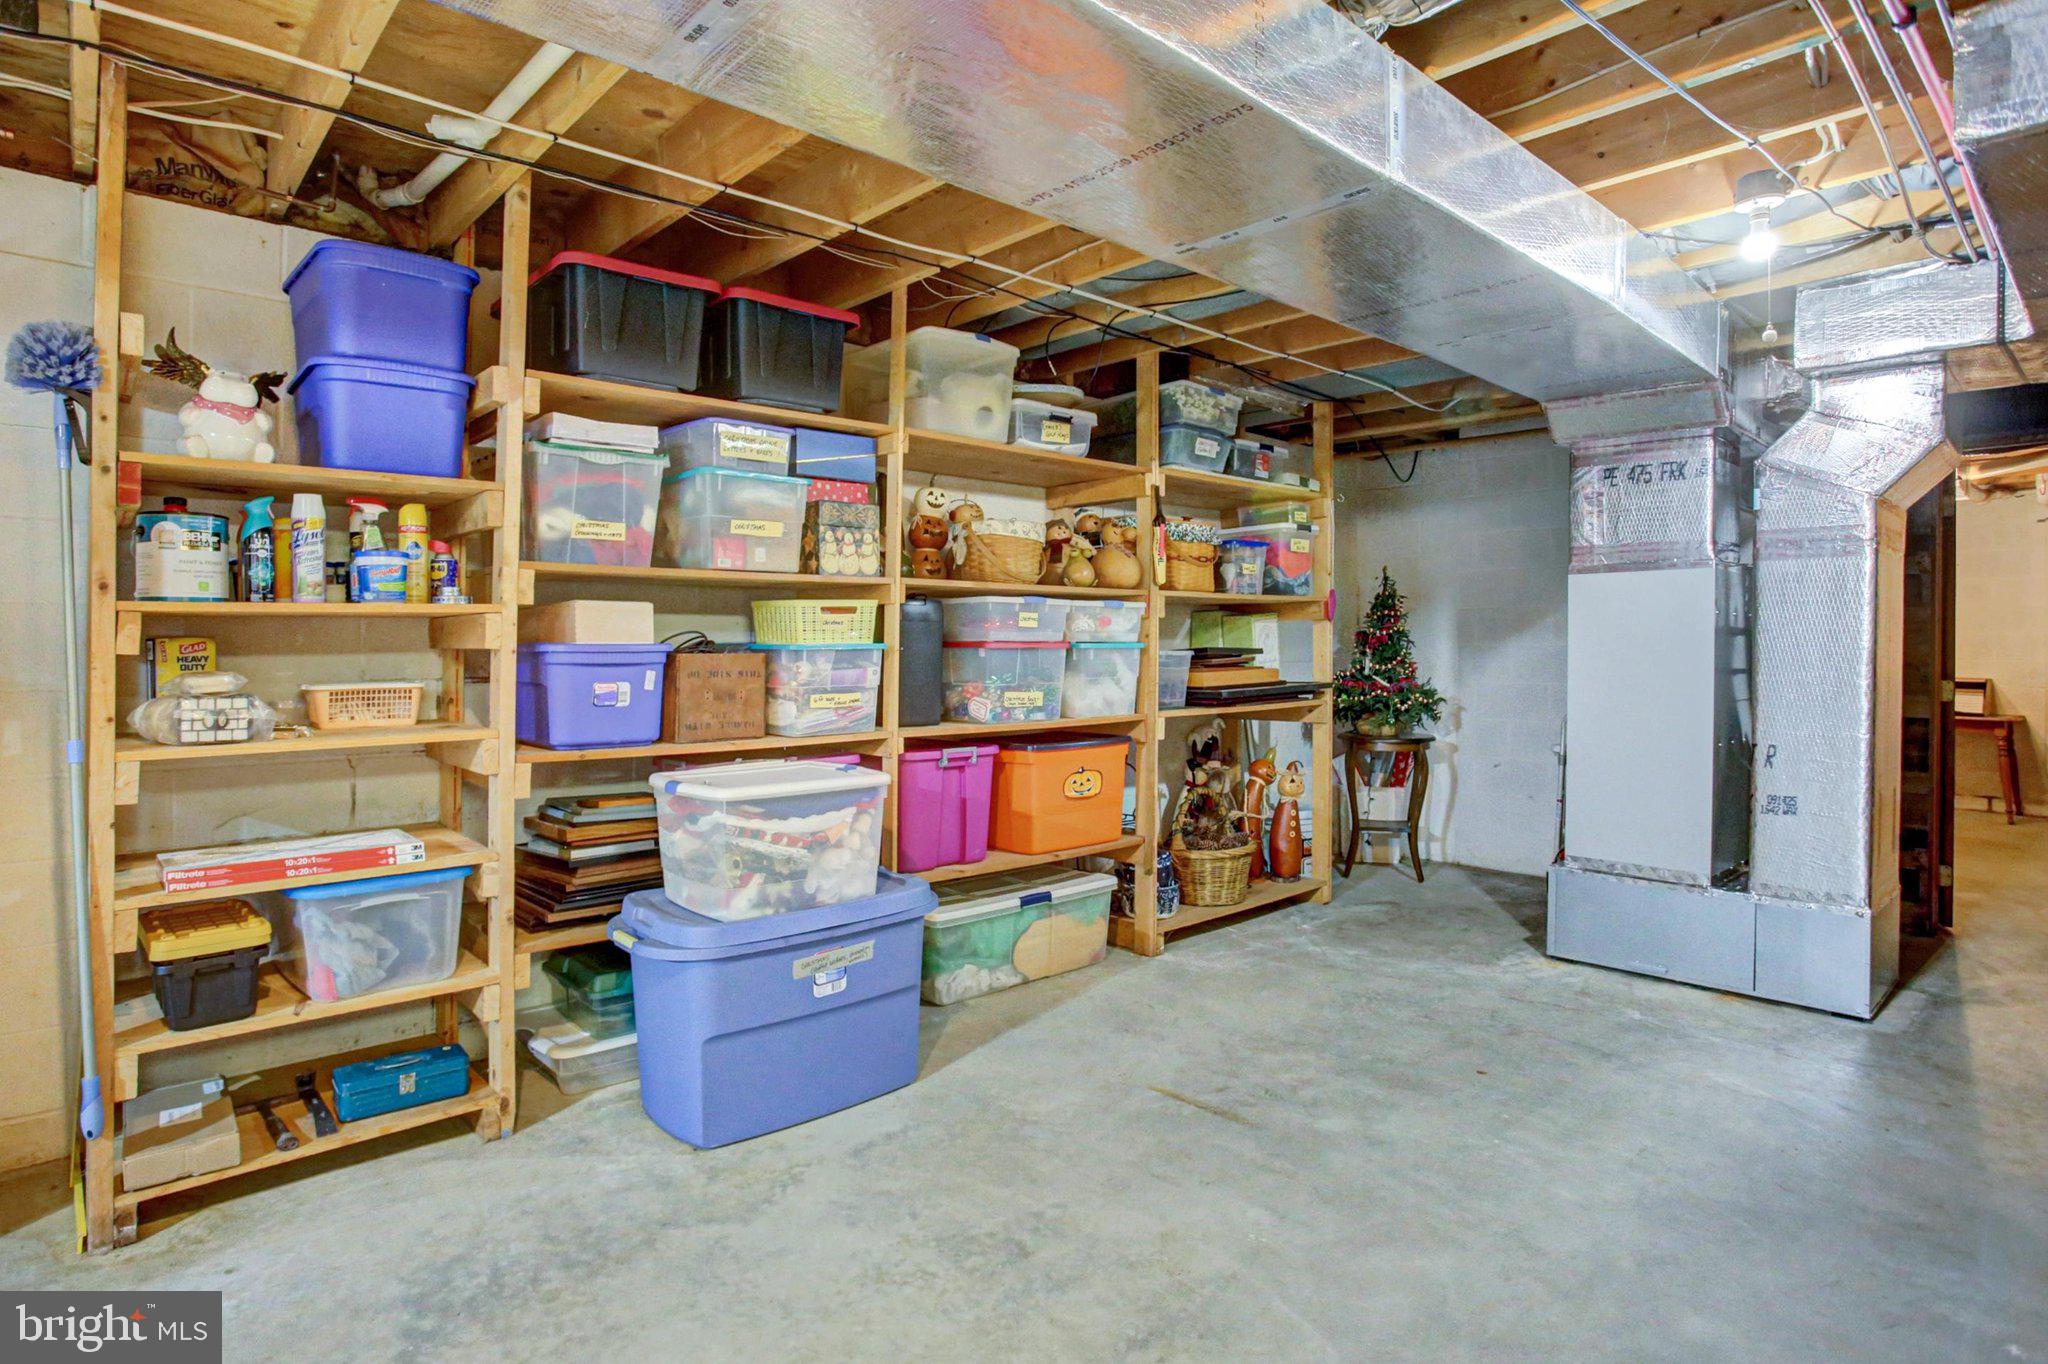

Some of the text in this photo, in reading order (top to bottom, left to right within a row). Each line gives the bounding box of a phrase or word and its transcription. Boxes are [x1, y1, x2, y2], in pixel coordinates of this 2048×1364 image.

[180, 642, 206, 654] GLAD
[176, 655, 209, 664] HEAVY
[180, 663, 206, 672] DUTY
[1764, 744, 1777, 769] R
